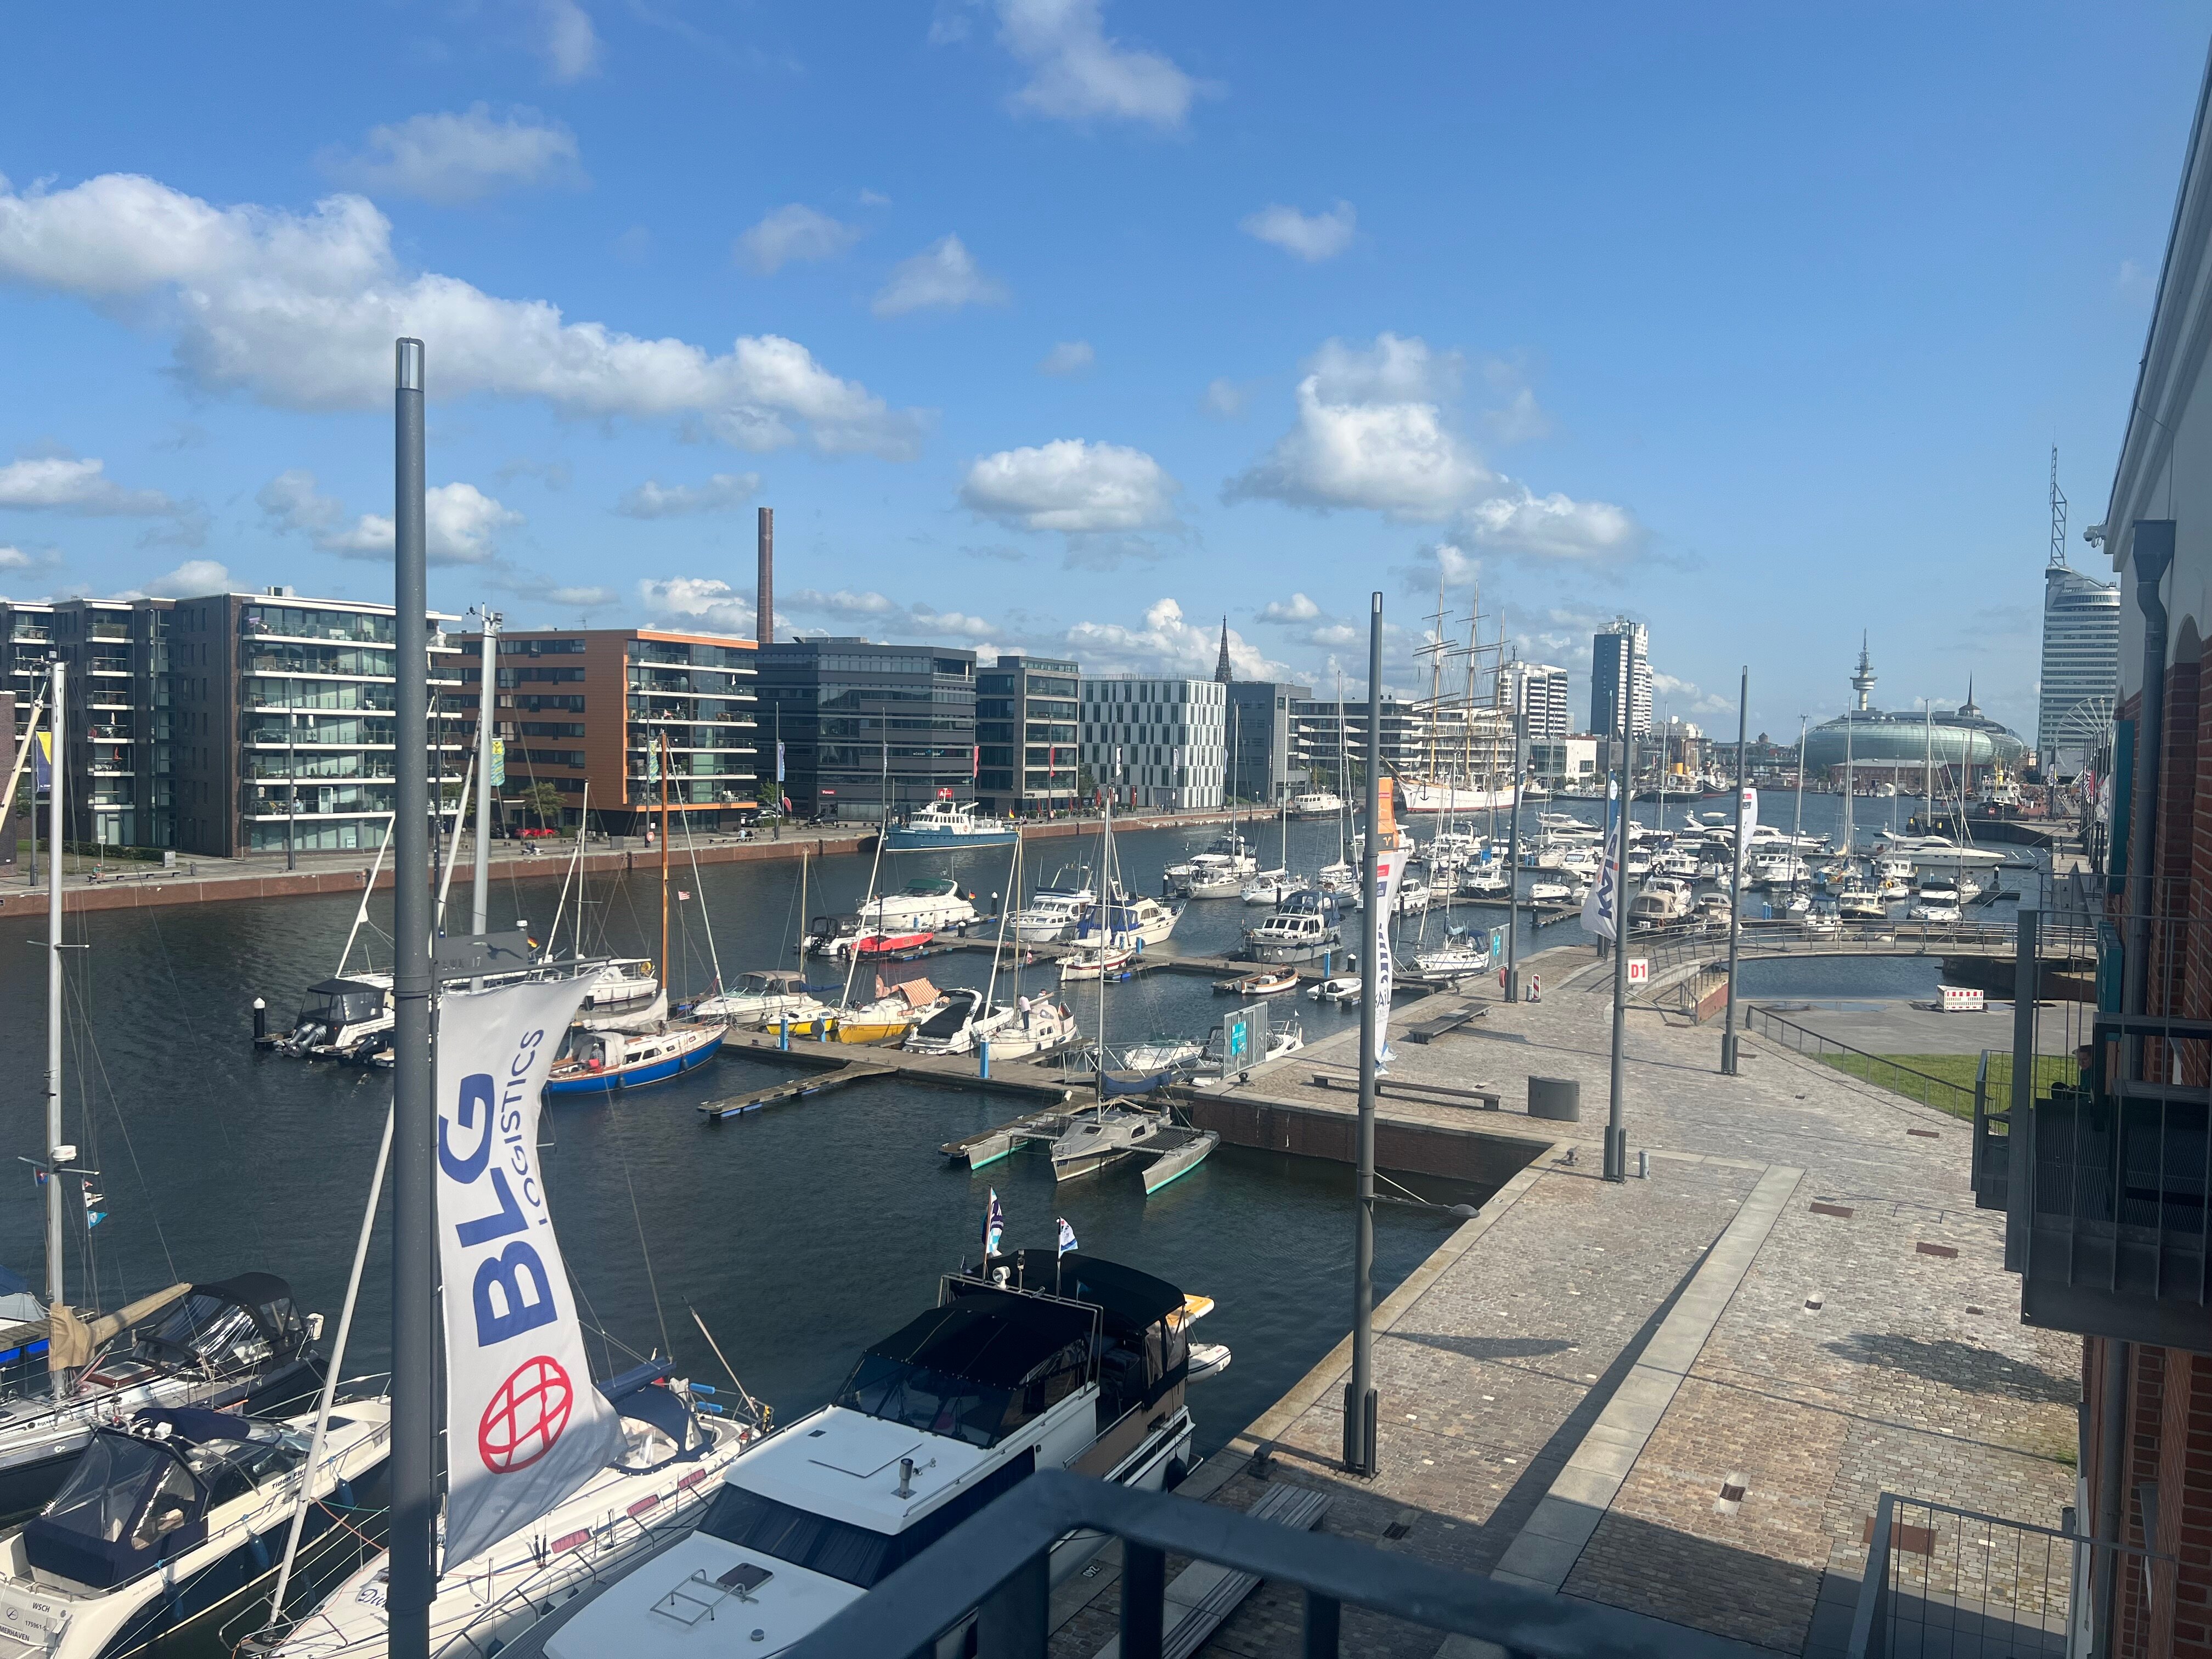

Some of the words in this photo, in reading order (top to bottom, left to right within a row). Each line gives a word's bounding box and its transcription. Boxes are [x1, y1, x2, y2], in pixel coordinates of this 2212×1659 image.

[1631, 963, 1645, 978] D1
[438, 1073, 558, 1347] BLG
[1082, 1565, 1101, 1578] 240
[32, 1602, 50, 1613] WSCH
